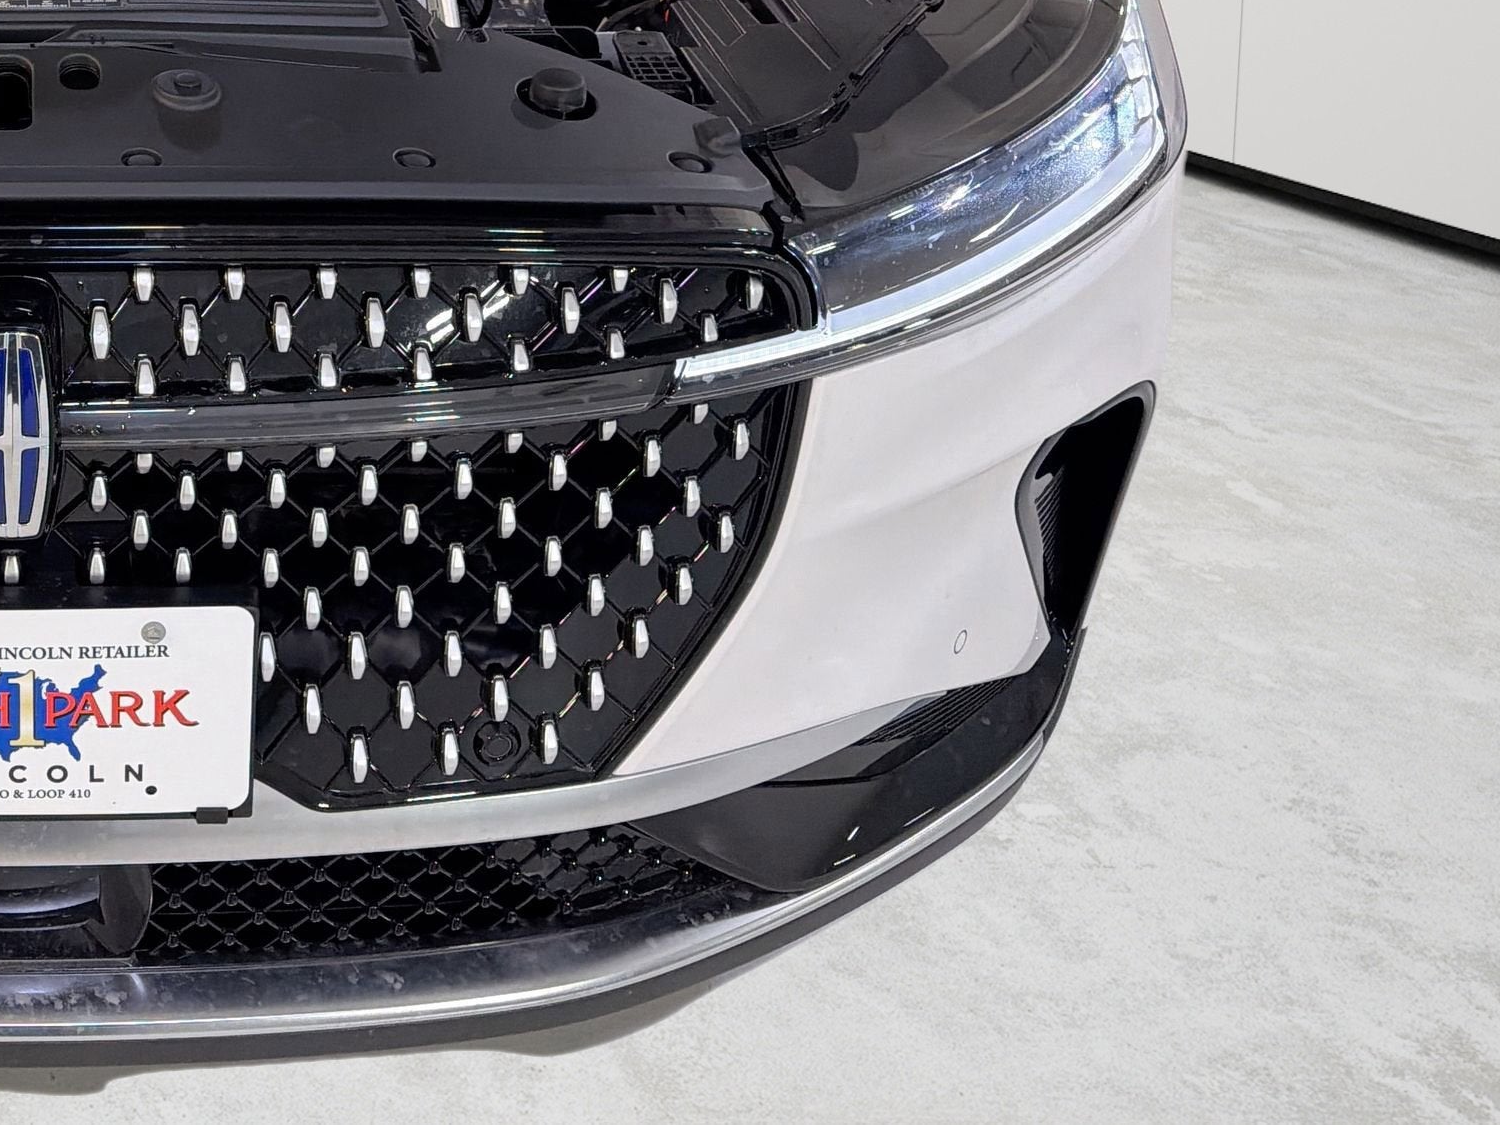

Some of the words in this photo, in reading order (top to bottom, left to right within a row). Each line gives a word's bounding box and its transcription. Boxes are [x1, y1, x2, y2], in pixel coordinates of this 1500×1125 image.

[78, 645, 170, 659] RETAILER
[44, 689, 200, 730] PARK
[13, 789, 24, 800] &
[27, 789, 66, 800] LOOP
[68, 789, 91, 800] 410
